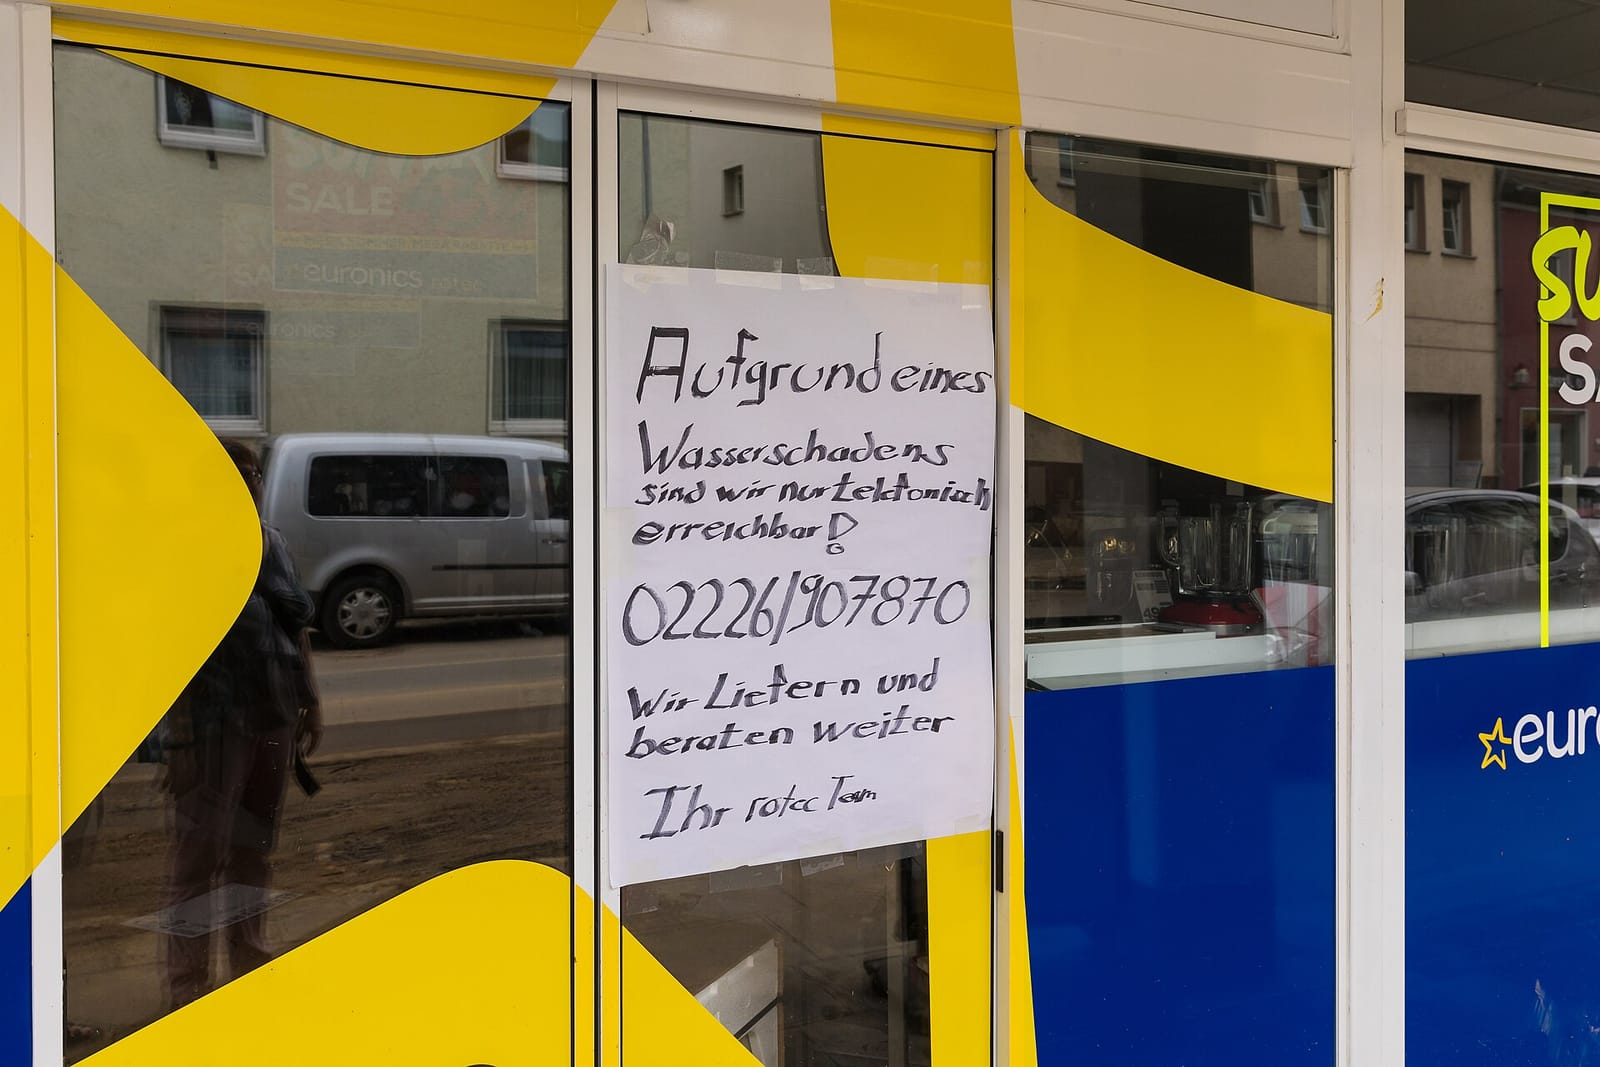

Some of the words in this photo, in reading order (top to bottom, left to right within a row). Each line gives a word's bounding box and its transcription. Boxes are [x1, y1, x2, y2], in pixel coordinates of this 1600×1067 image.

[286, 182, 394, 216] SALE
[304, 263, 423, 289] euronics
[636, 326, 883, 407] Aufgrund
[891, 362, 992, 393] eines
[1558, 333, 1600, 405] S
[638, 420, 954, 474] Wasserschadens
[635, 480, 706, 505] sind
[716, 480, 776, 502] wir
[778, 481, 831, 502] nur
[622, 571, 970, 646] 02226/907870
[627, 687, 699, 720] Wir
[704, 664, 860, 709] Liefern
[877, 657, 939, 694] und
[625, 723, 793, 759] beraten
[814, 705, 955, 743] weiter
[1513, 706, 1600, 764] eur
[640, 784, 733, 840] Ihr
[745, 785, 818, 822] rotec
